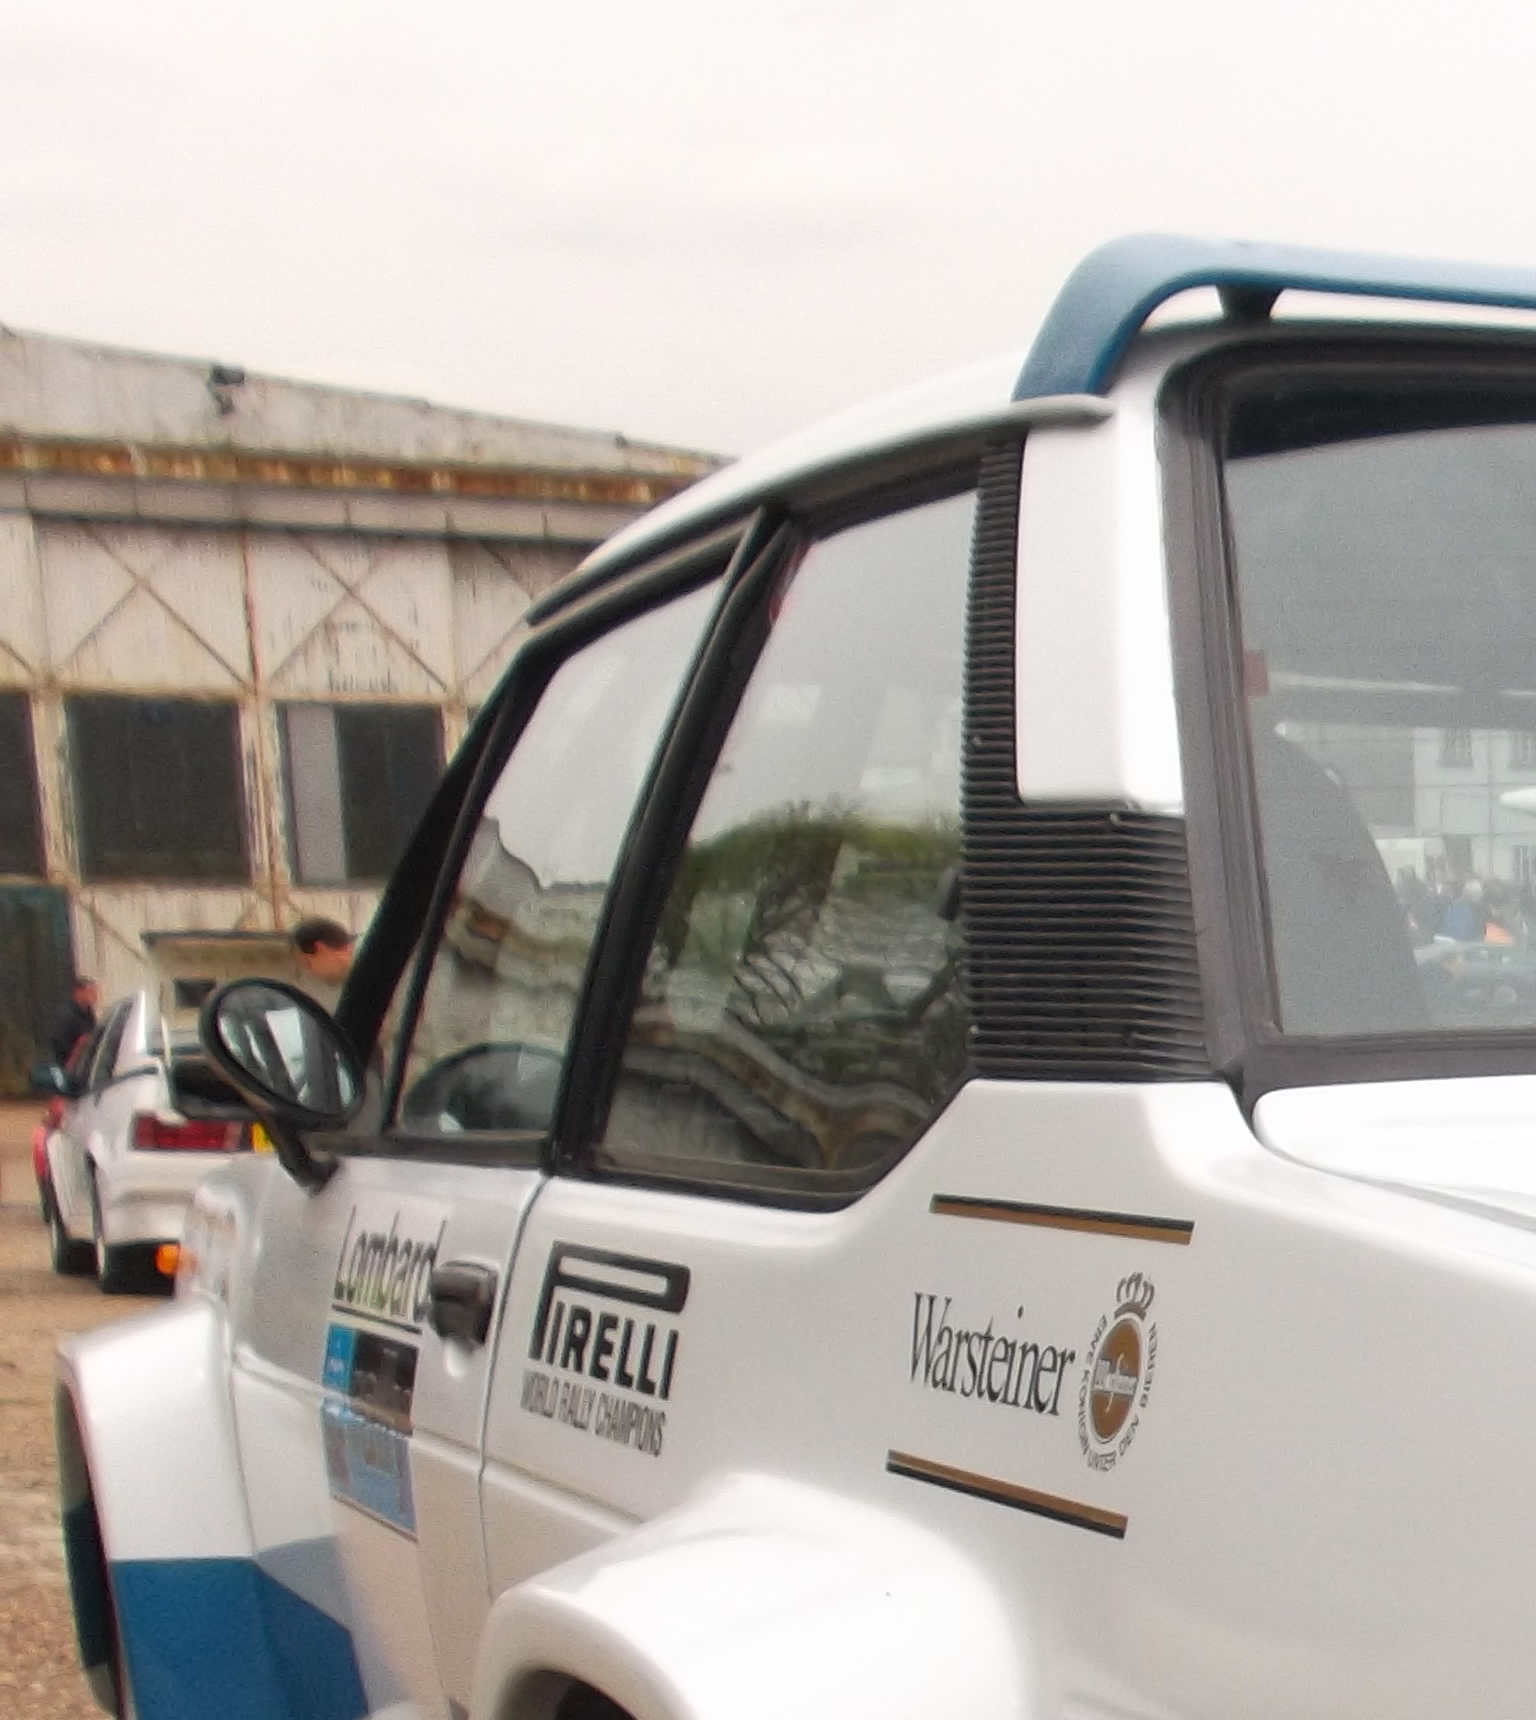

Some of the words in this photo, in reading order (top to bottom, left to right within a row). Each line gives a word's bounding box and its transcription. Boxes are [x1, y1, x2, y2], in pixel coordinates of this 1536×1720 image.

[527, 1240, 691, 1400] PIRELLI
[909, 1291, 1076, 1417] Warsteiner
[520, 1369, 560, 1419] WORLD
[558, 1380, 597, 1431] RALLY
[593, 1390, 667, 1458] CHAMPIONS
